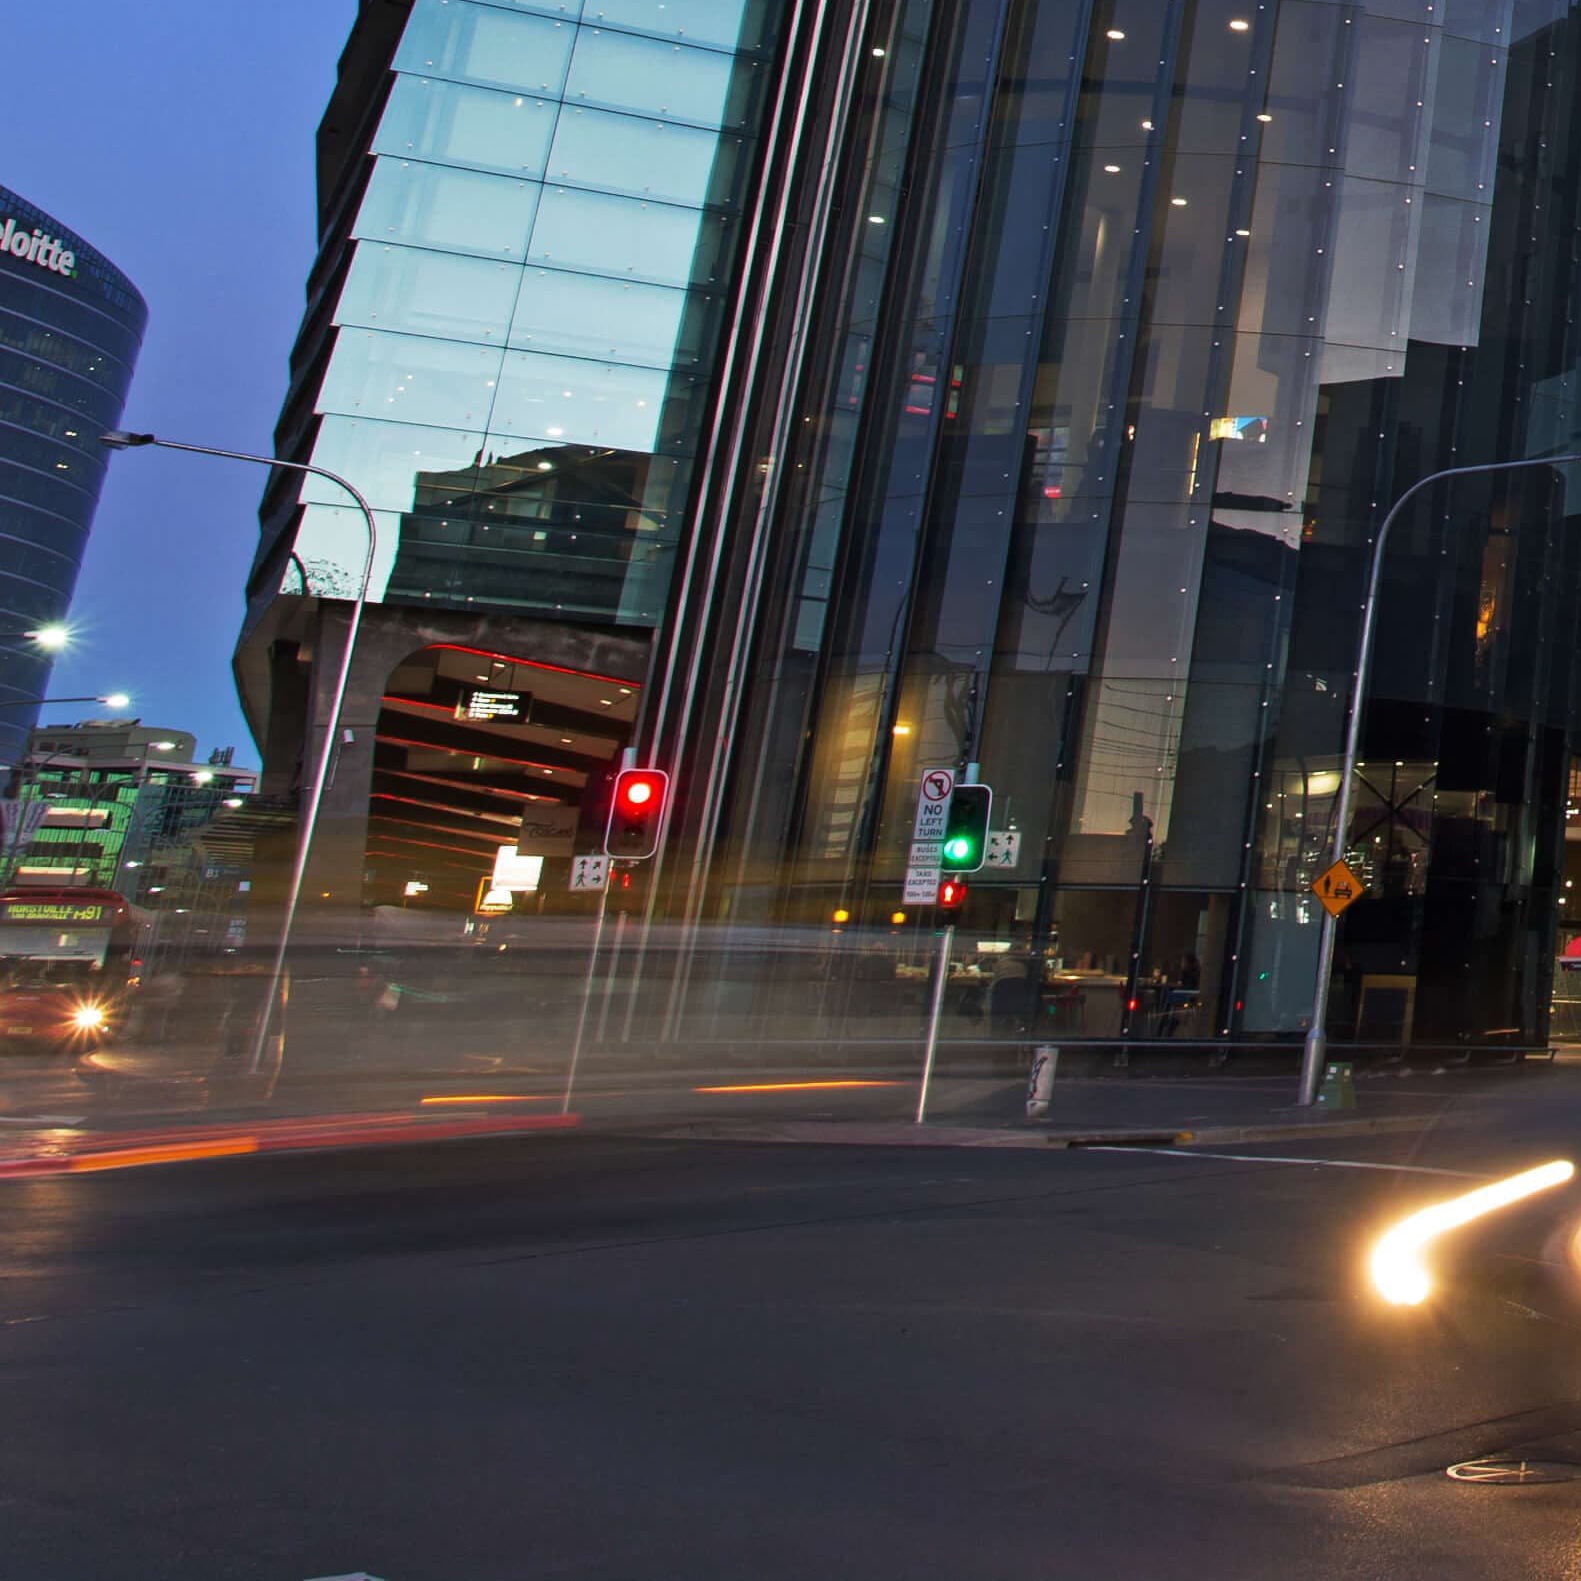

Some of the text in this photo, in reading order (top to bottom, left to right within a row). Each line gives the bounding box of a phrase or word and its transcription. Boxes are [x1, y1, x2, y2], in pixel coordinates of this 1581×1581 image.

[923, 805, 943, 816] NO
[920, 818, 943, 827] LEFT
[918, 828, 943, 837] TURN
